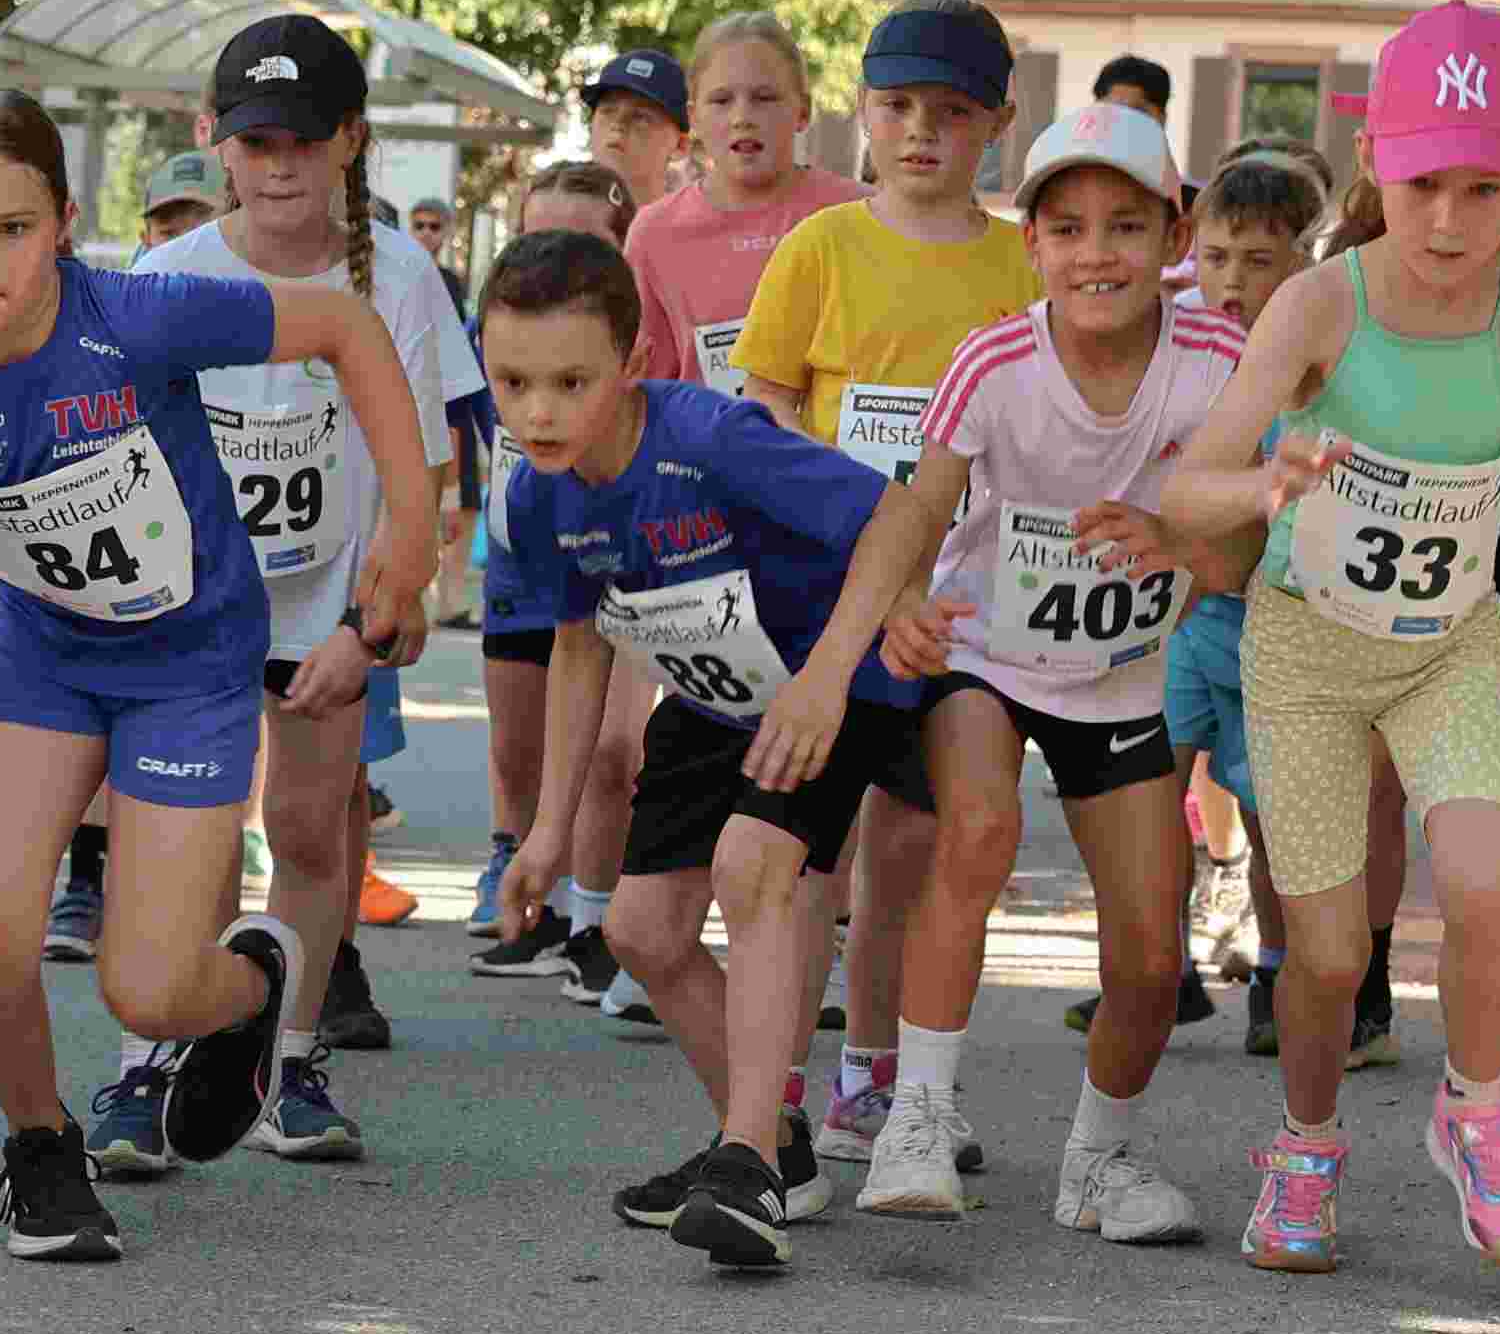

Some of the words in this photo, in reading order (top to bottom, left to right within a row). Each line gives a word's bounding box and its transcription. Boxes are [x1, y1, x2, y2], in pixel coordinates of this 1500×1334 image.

[45, 383, 138, 439] TVH
[30, 466, 111, 503] HEPPENHEIM
[24, 525, 141, 591] 84
[1345, 526, 1459, 601] 33
[1026, 567, 1176, 642] 403
[136, 755, 206, 777] CRAFT
